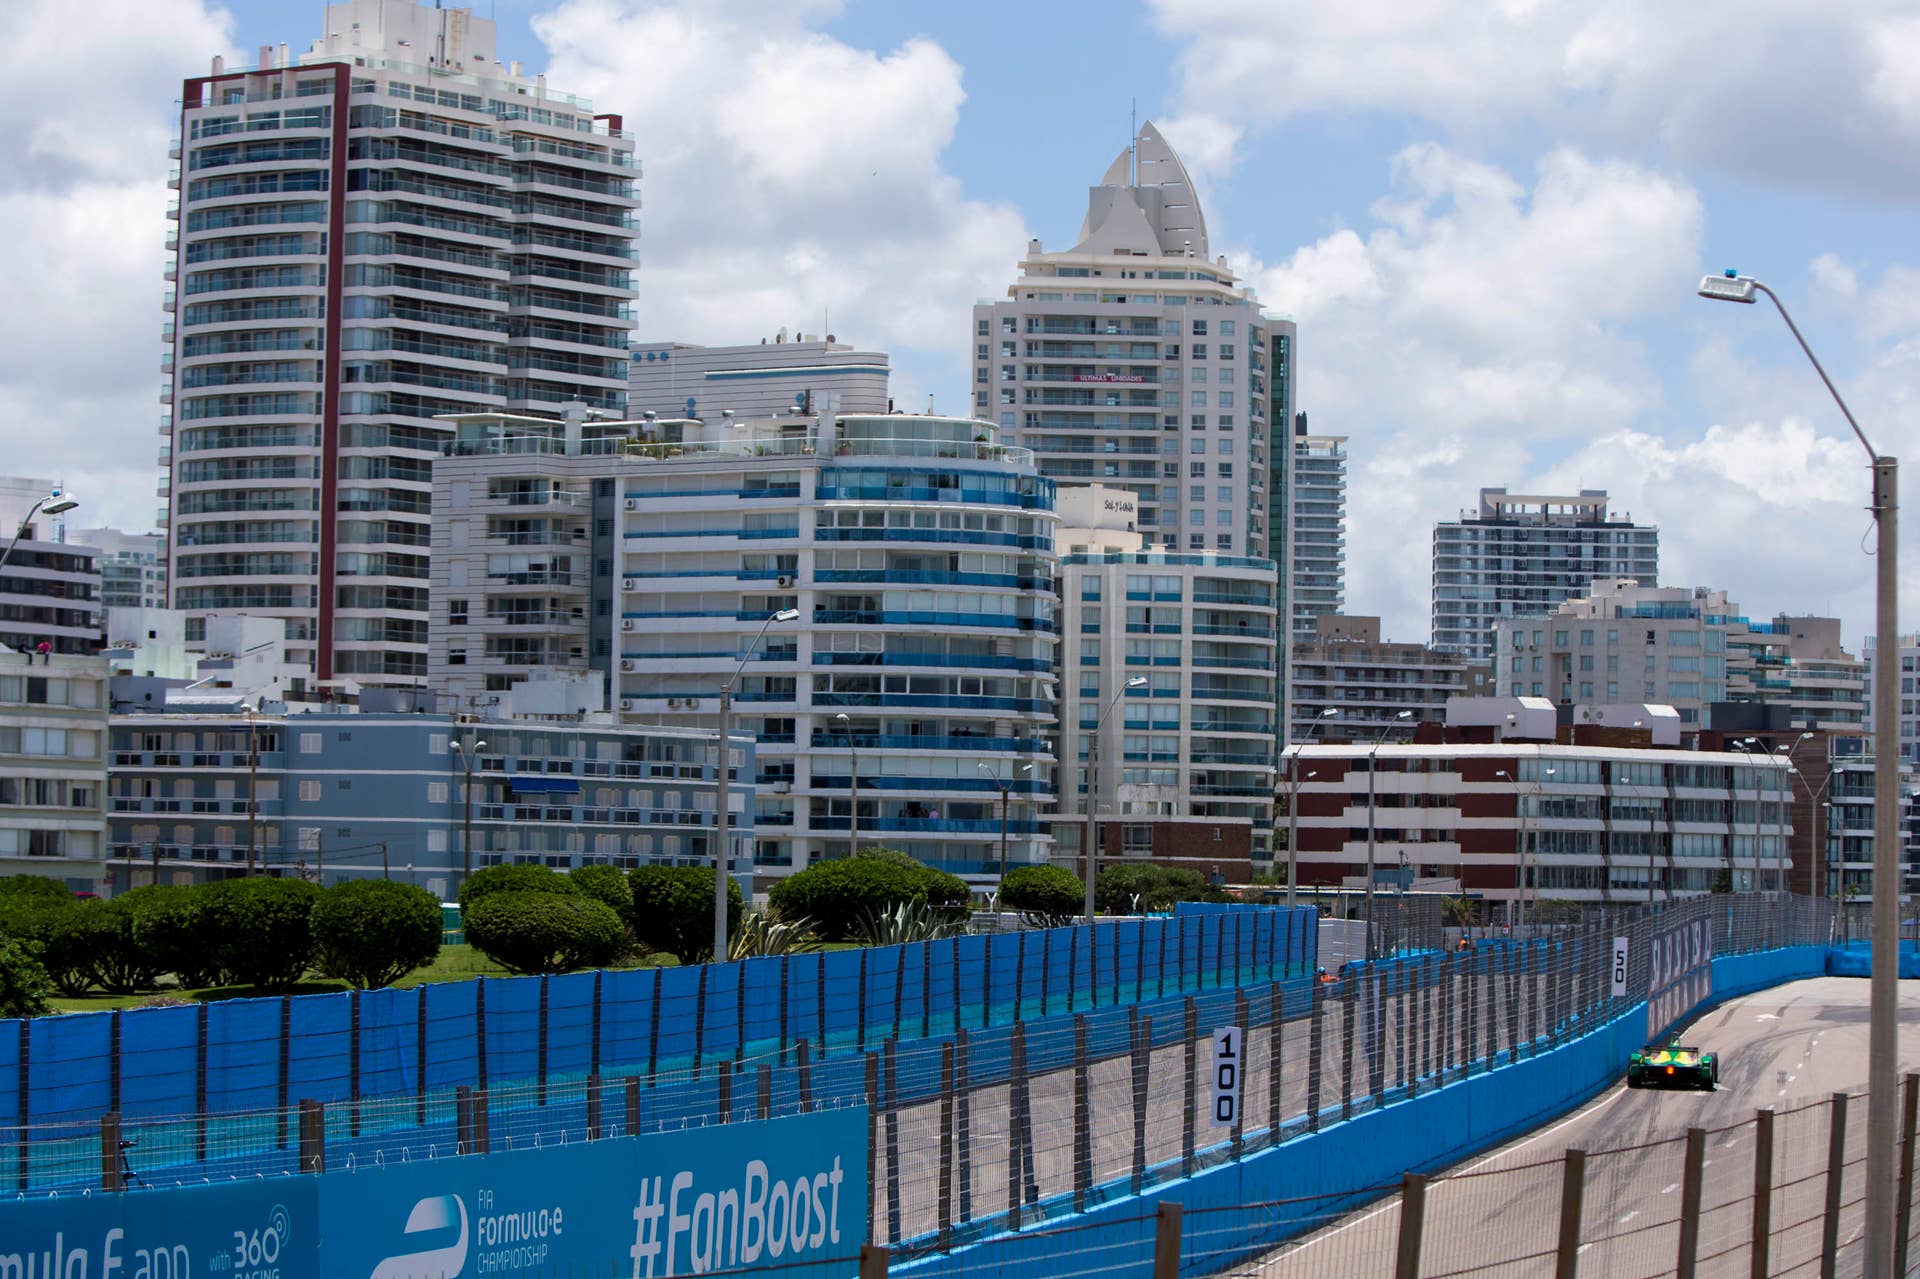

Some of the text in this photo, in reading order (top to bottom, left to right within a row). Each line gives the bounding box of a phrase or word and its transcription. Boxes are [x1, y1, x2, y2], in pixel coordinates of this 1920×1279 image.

[1615, 950, 1624, 983] 50
[1216, 1032, 1236, 1122] 100
[478, 1189, 493, 1211] FIA
[630, 1155, 844, 1279] #FanBoost
[209, 1249, 231, 1271] with
[477, 1243, 548, 1274] CHAMPIONSHIP
